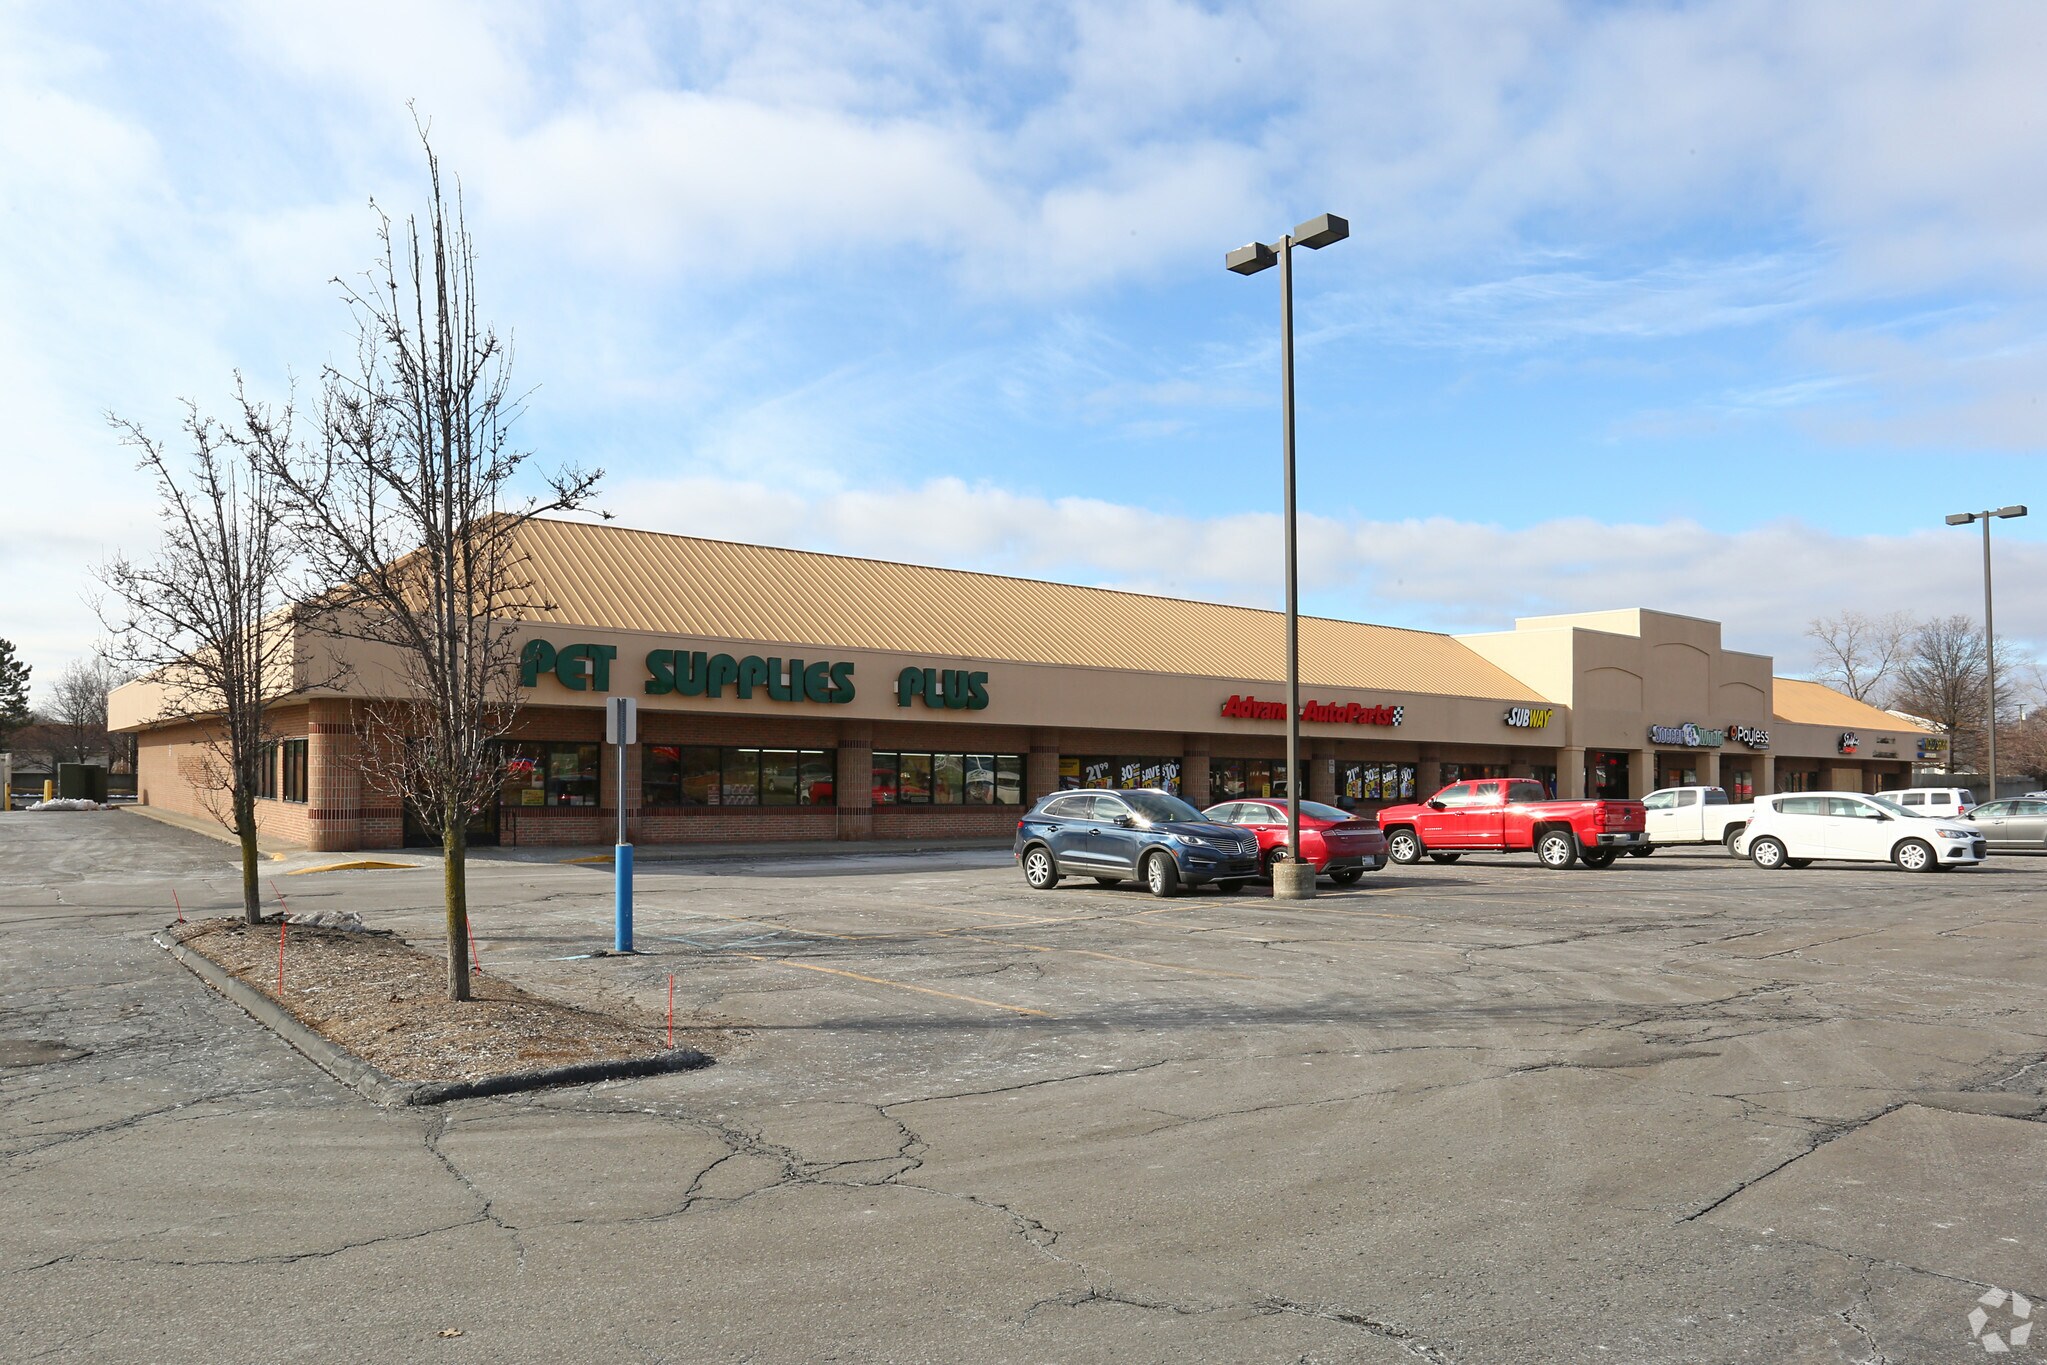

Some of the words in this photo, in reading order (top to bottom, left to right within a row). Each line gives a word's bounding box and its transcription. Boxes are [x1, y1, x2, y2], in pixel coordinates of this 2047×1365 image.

[520, 638, 617, 692] PET
[645, 648, 856, 704] SUPPLIES
[897, 666, 990, 711] PLUS
[1221, 695, 1288, 721] Advan
[1507, 706, 1553, 728] SUBWAY
[1737, 726, 1769, 746] Payless
[1142, 764, 1160, 782] SAVE
[1382, 769, 1398, 784] SAVE
